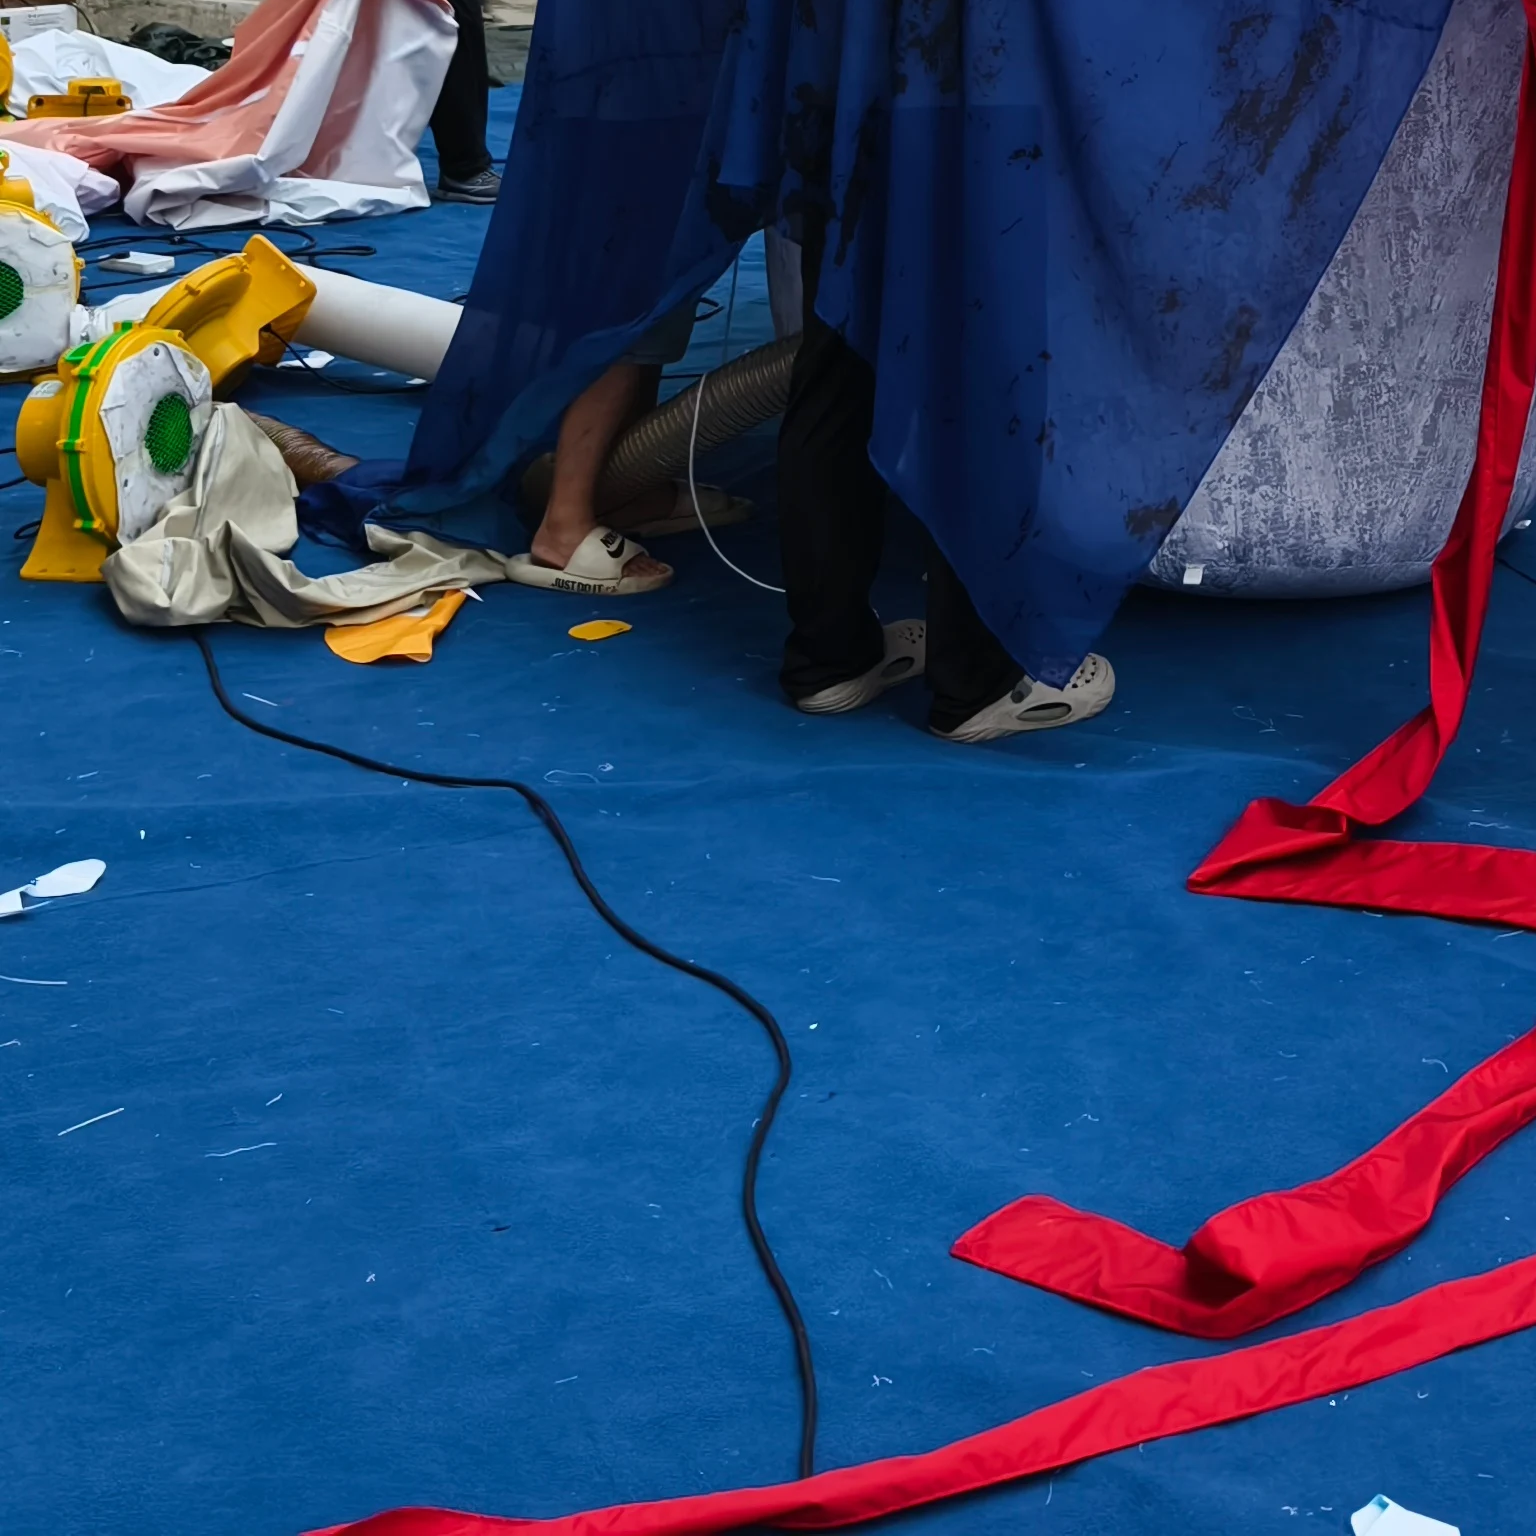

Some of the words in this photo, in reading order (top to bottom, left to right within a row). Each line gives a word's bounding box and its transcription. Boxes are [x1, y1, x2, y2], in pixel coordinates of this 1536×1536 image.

[550, 577, 577, 591] JUST
[577, 581, 592, 593] DO
[592, 583, 605, 594] IT
